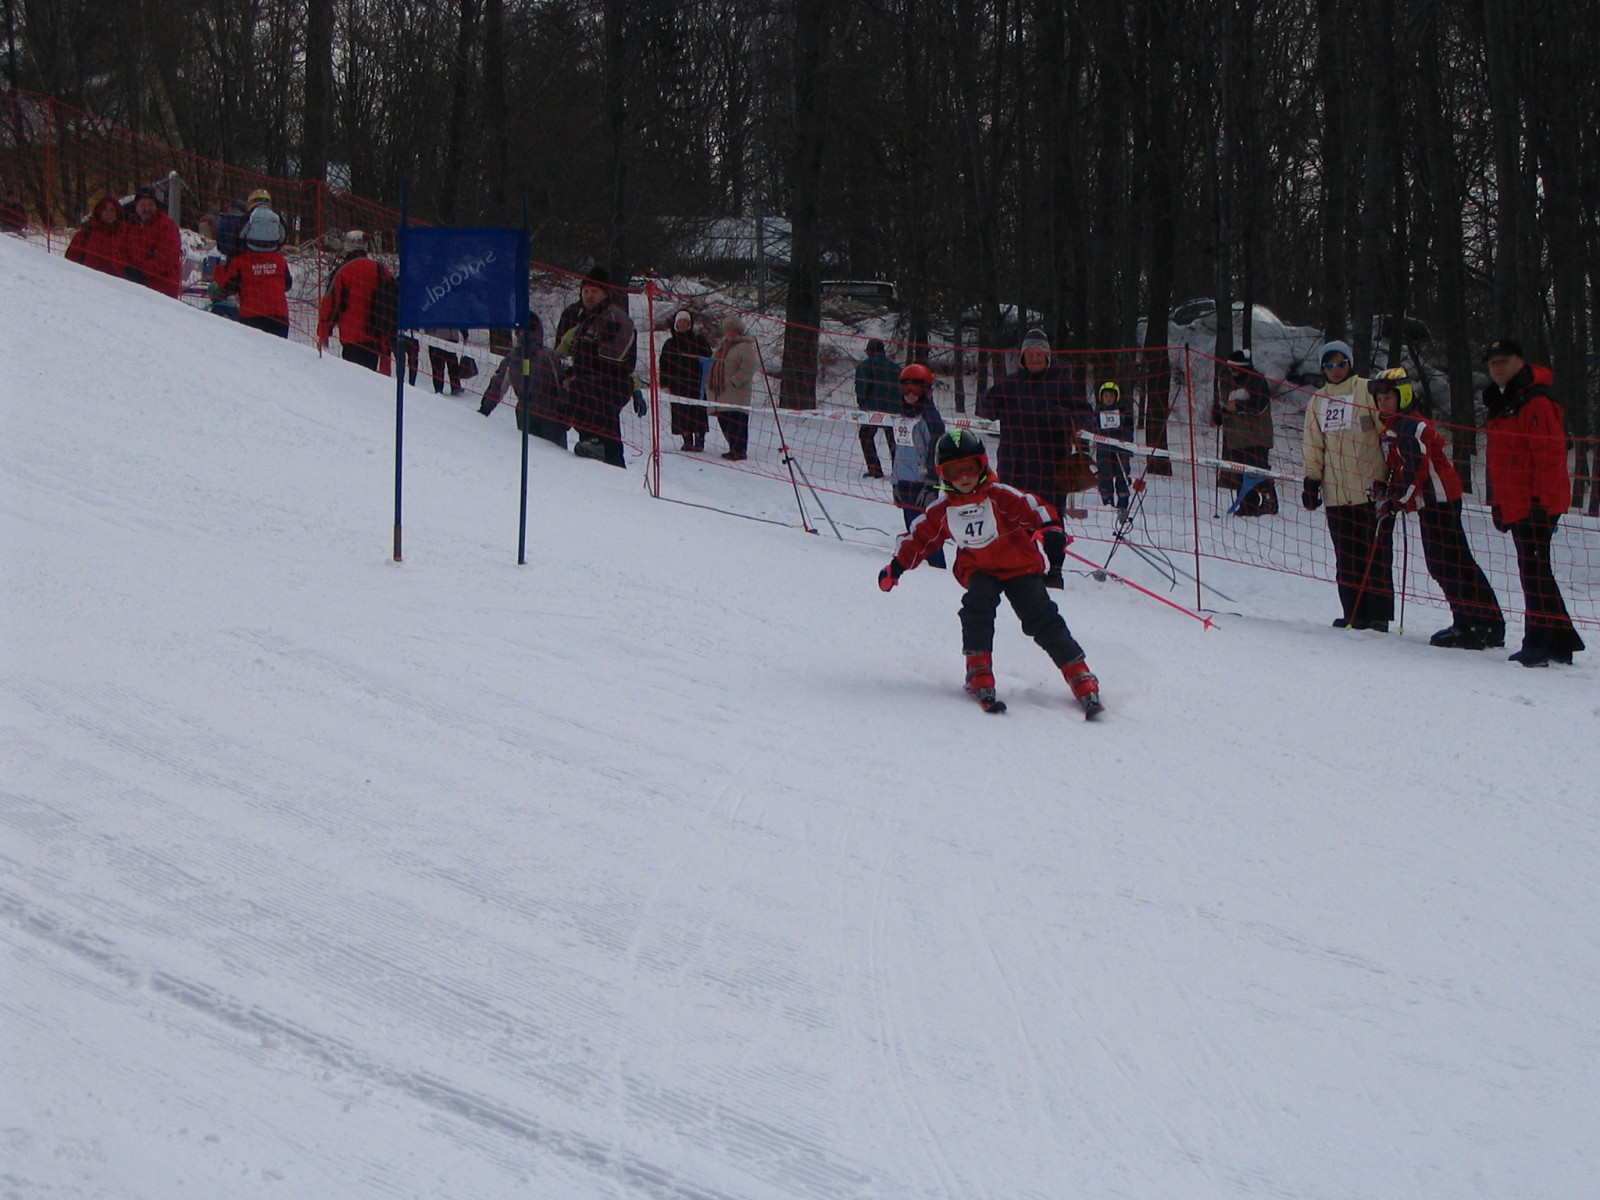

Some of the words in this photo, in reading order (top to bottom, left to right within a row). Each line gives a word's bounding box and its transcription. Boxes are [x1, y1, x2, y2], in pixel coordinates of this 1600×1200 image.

[1326, 408, 1345, 421] 221
[898, 426, 908, 437] 99
[965, 520, 984, 537] 47
